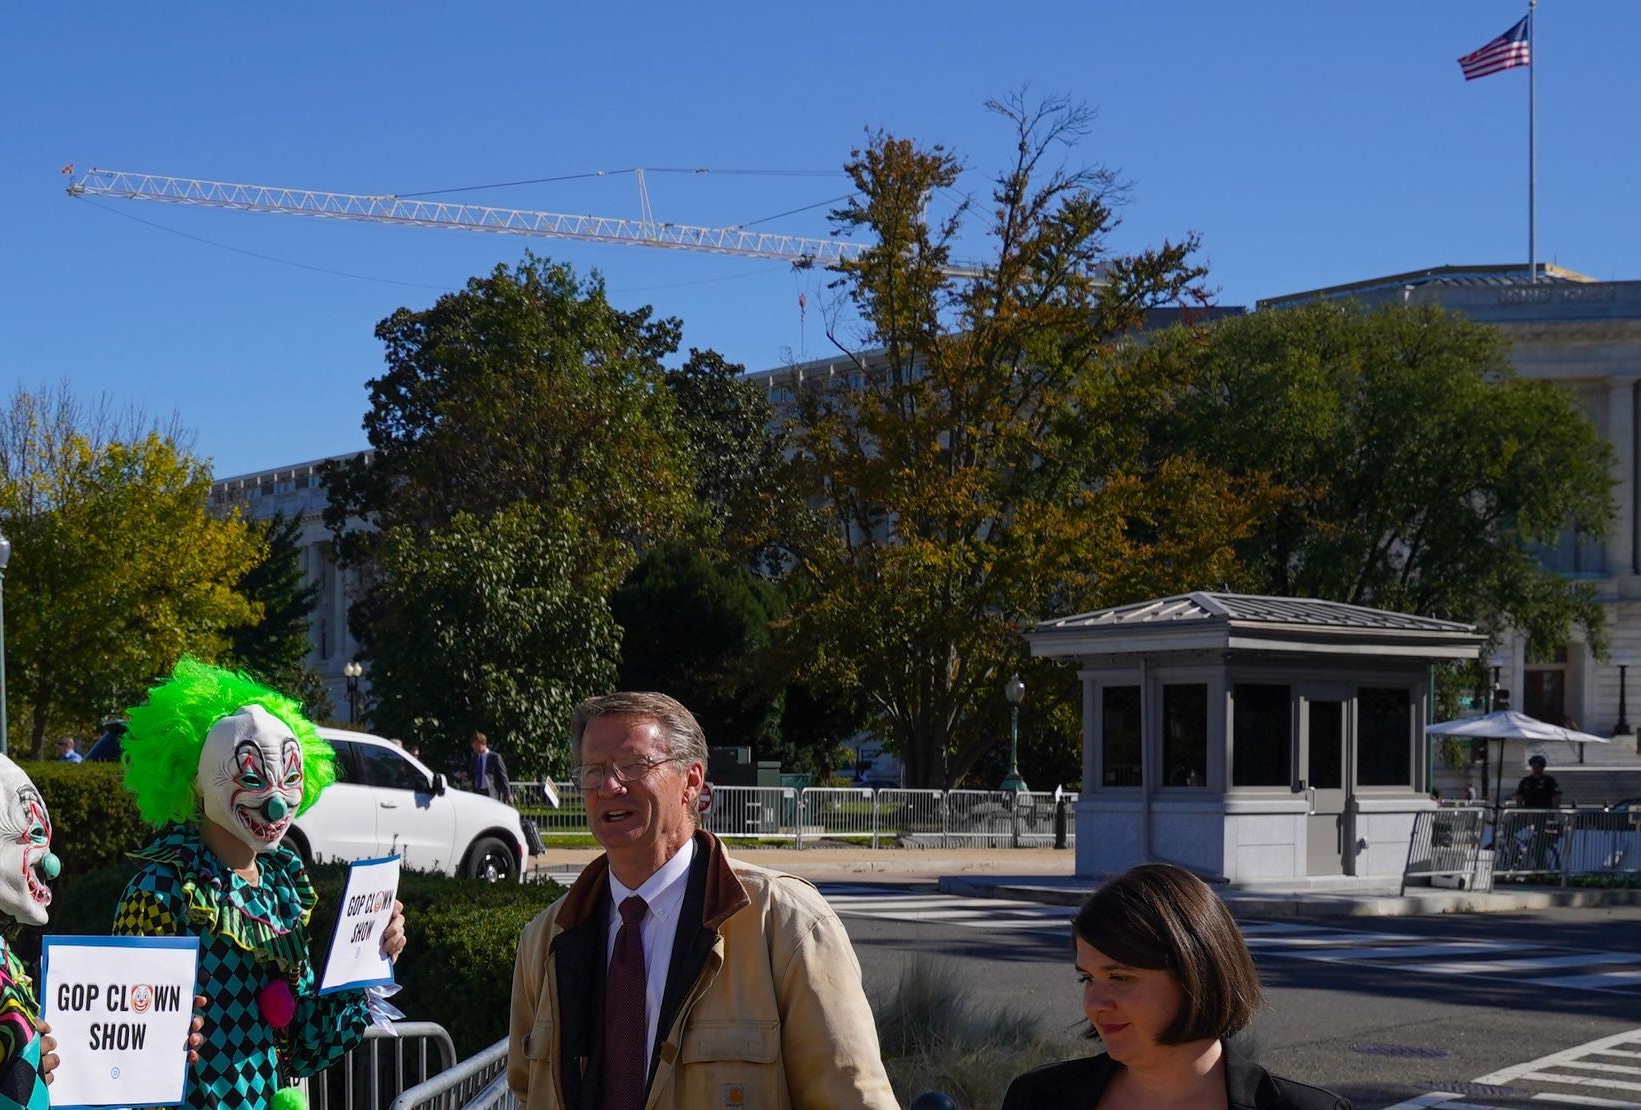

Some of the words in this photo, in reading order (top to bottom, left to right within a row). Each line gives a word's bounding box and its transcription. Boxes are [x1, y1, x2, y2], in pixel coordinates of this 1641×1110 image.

[347, 895, 366, 917] GOP
[365, 889, 394, 915] CLWN
[351, 920, 375, 943] SHOW
[58, 984, 100, 1011] GOP
[107, 984, 181, 1014] CLWN
[89, 1023, 147, 1050] SHOW
